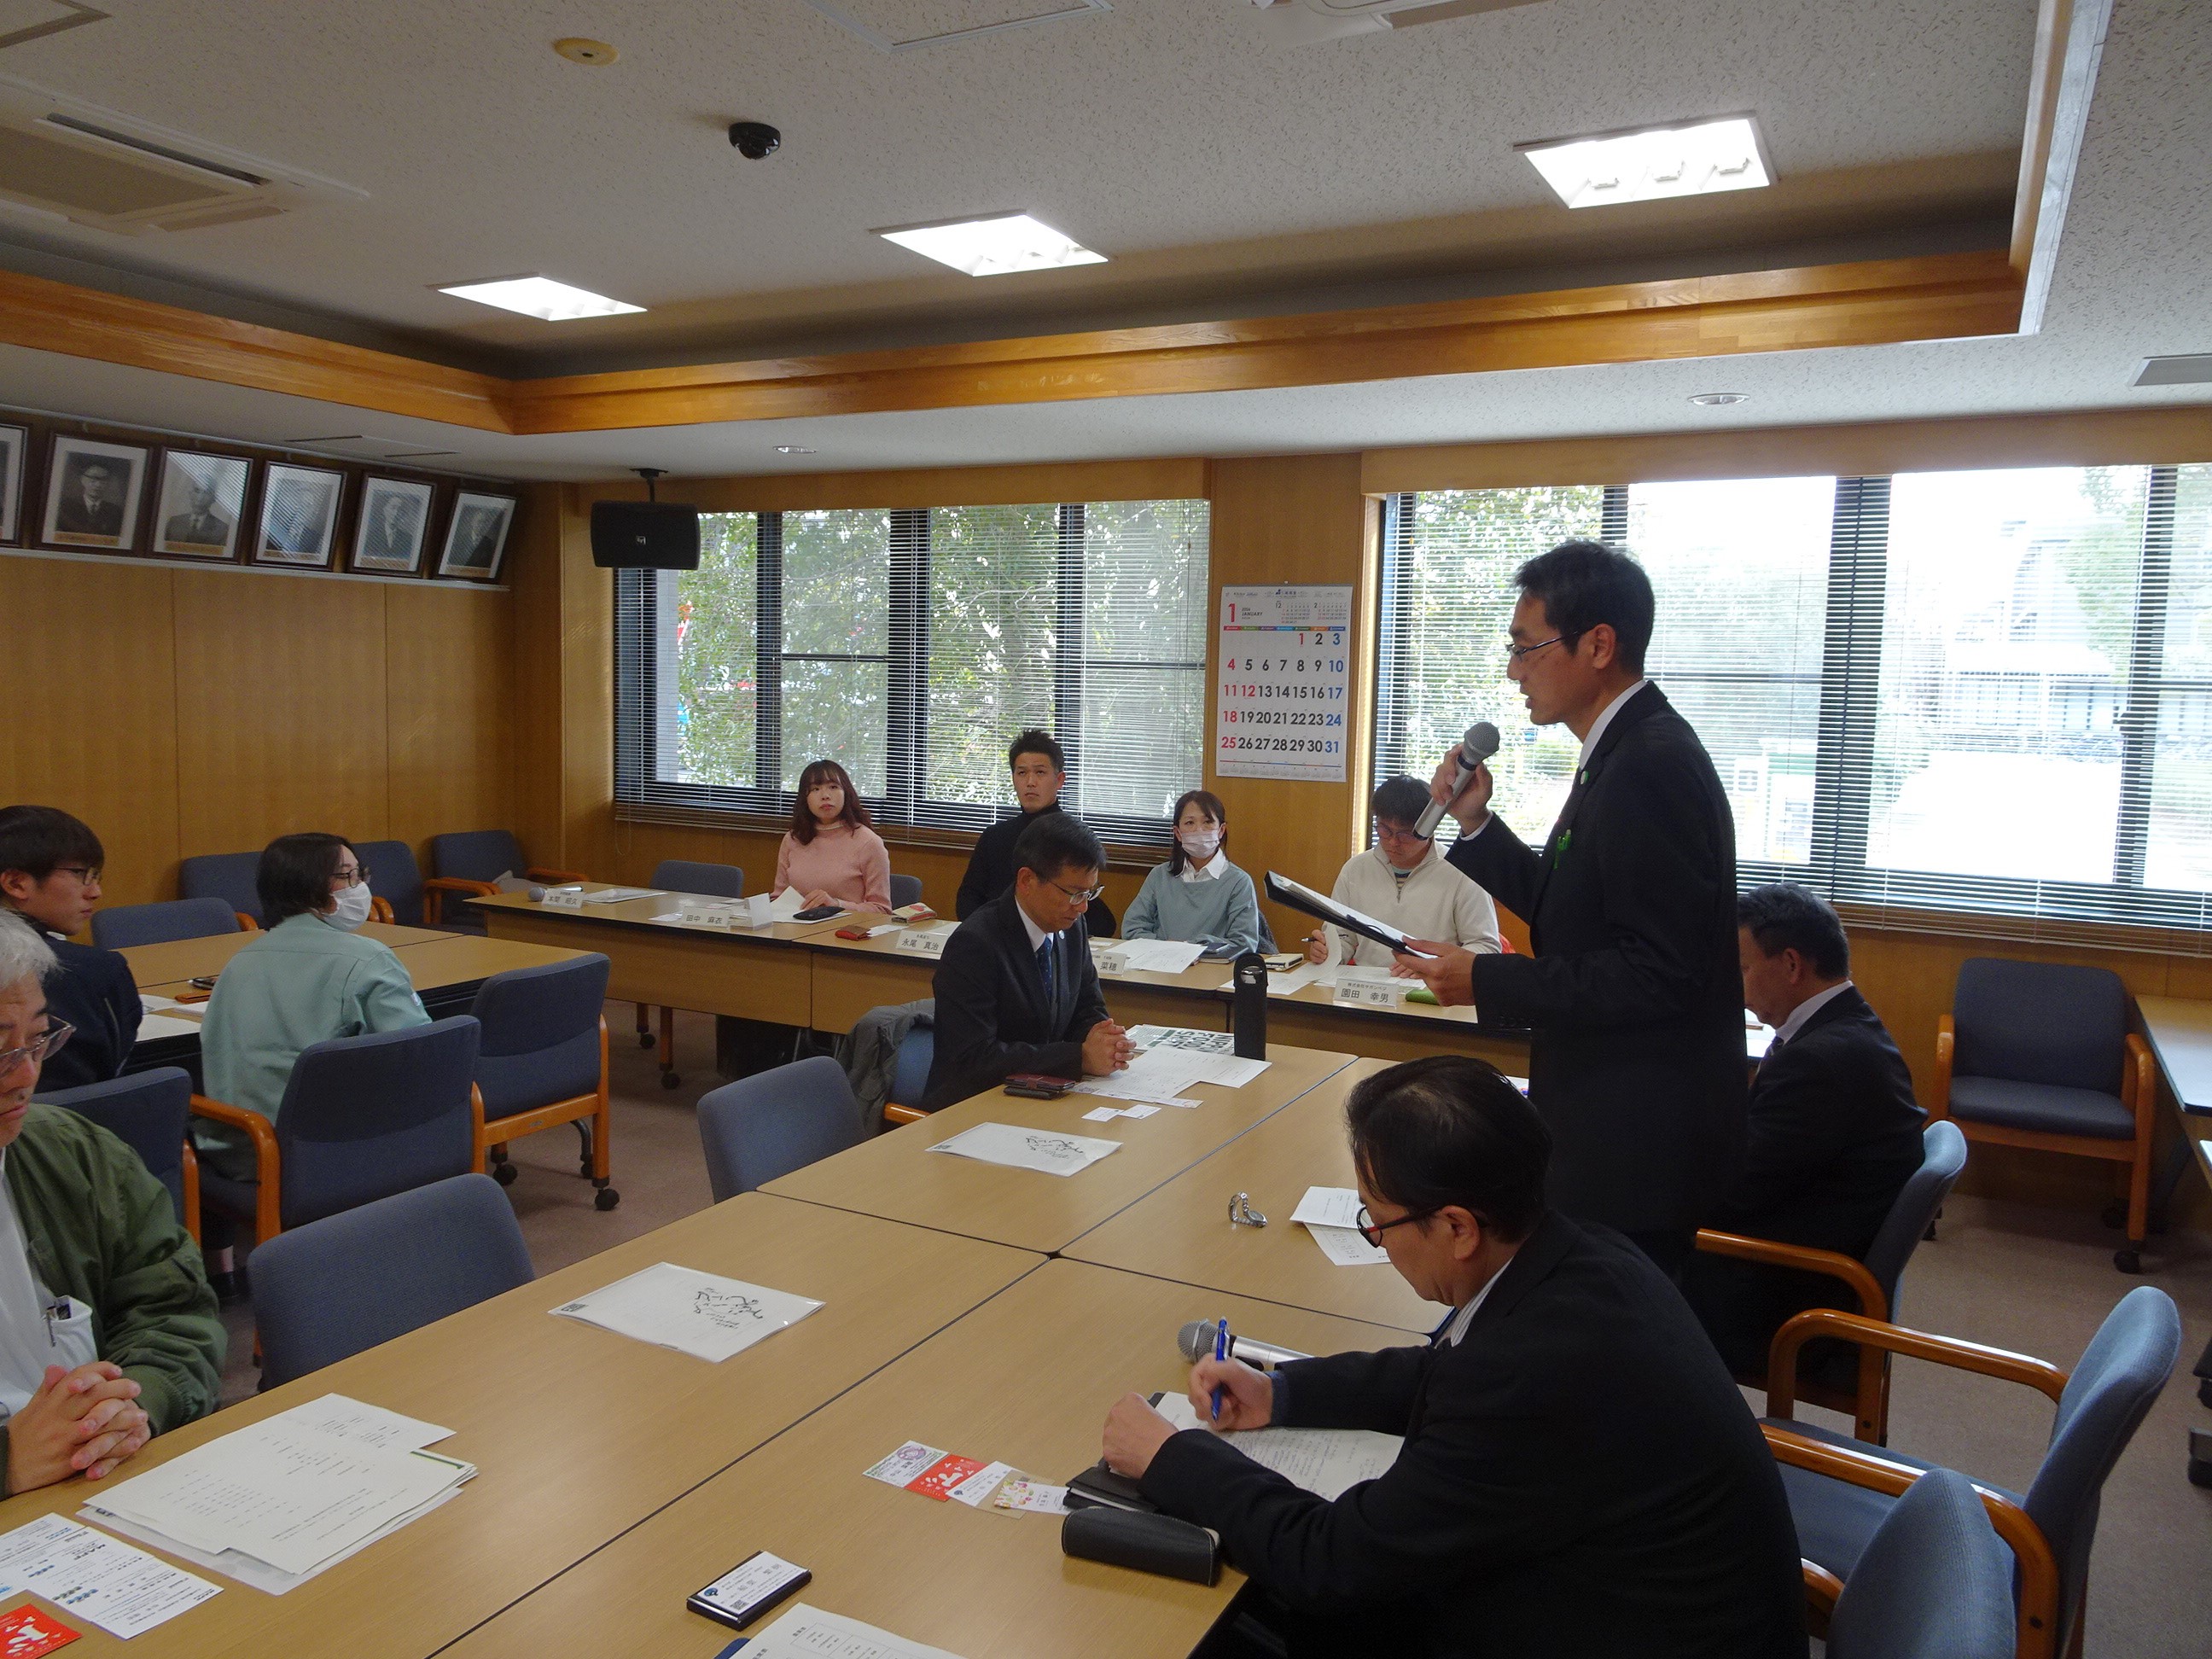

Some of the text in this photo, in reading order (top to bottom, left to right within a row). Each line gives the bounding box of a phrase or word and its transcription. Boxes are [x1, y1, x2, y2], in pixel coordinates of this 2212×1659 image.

[1228, 602, 1236, 623] 1
[1299, 632, 1341, 646] 1 2 3
[1227, 658, 1344, 673] 4 5 6 7 8 9 10
[1224, 684, 1343, 700] 11 12 13 14 15 16 17
[1223, 710, 1342, 726] 18 19 20 21 22 23 24
[1220, 736, 1339, 754] 25 26 27 28 29 30 31
[902, 939, 917, 947] 永尾
[1341, 988, 1389, 1003] 園田 幸男
